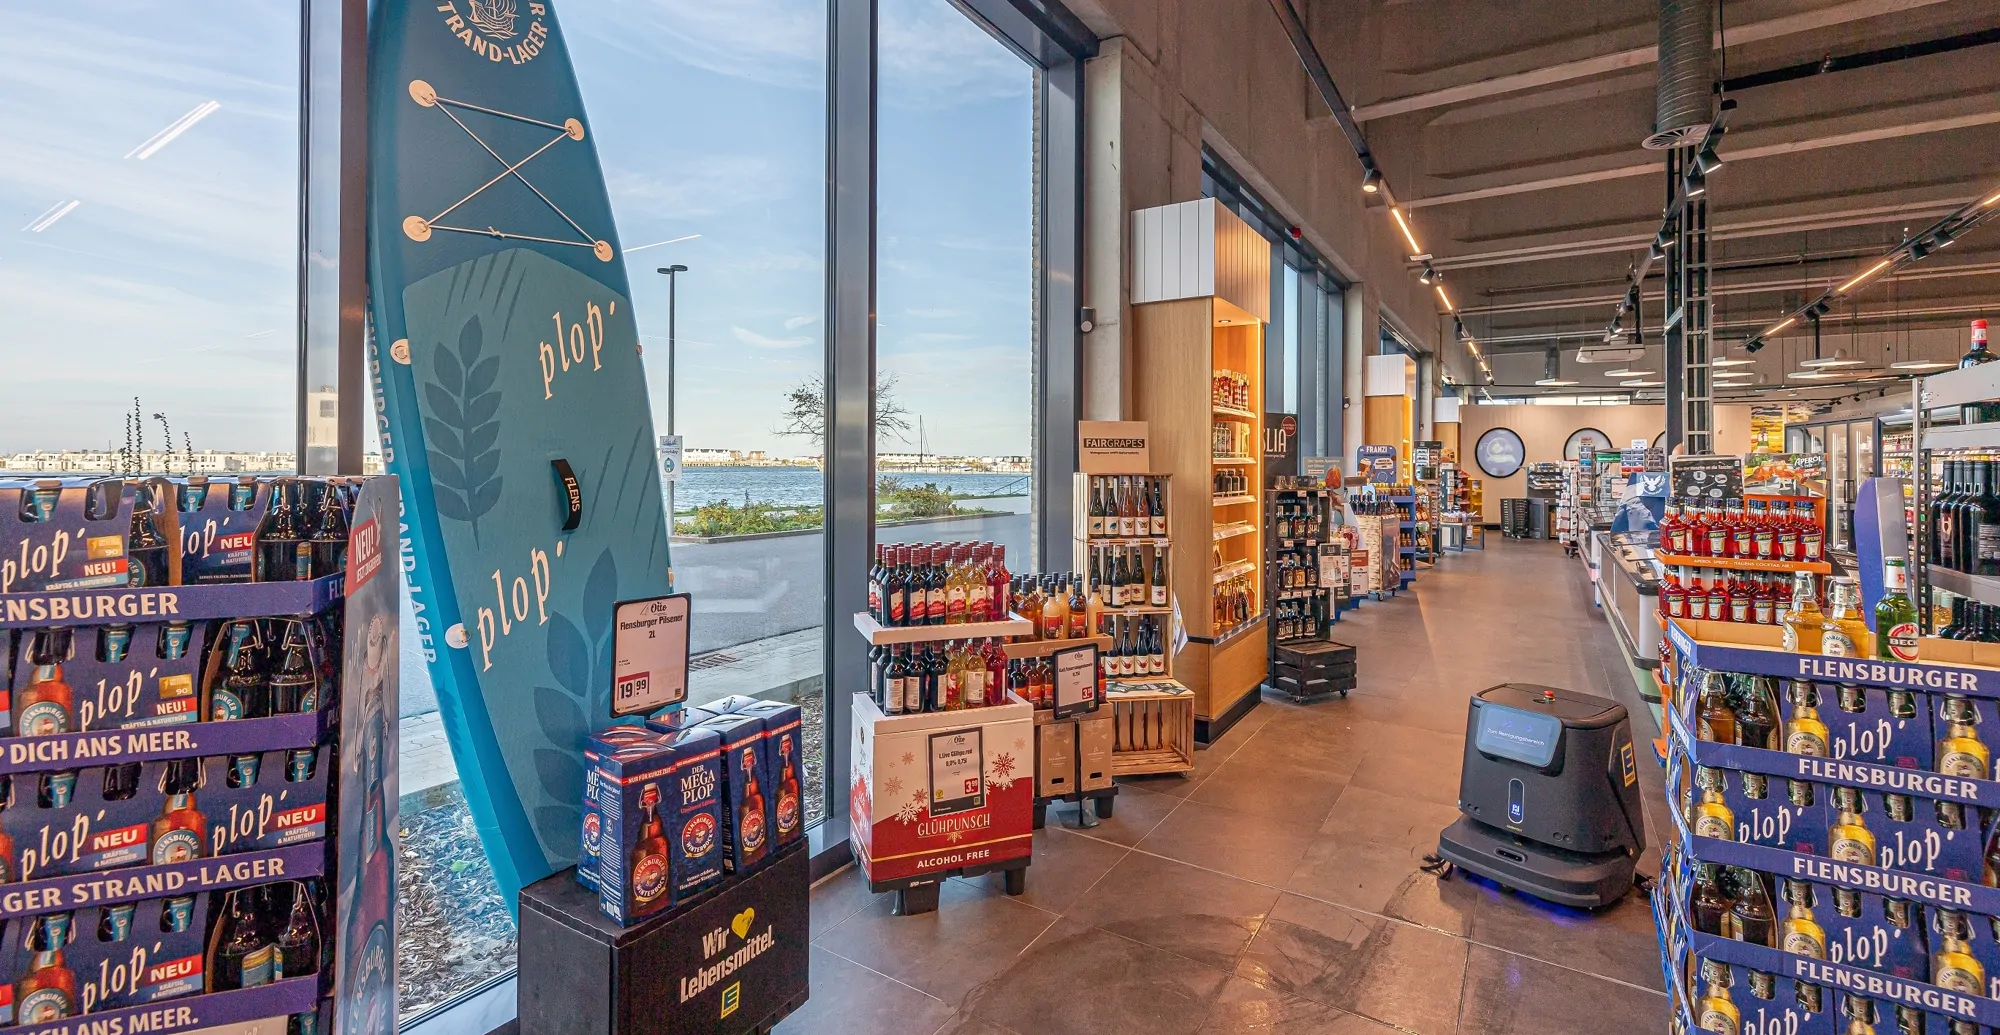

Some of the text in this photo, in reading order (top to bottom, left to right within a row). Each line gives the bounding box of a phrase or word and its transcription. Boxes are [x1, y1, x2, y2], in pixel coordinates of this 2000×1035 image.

[1086, 439, 1144, 448] FAIRGRAPES
[1795, 456, 1822, 466] APEROL
[565, 477, 580, 512] FLENS
[355, 525, 374, 565] NEU!
[84, 562, 117, 577] NEU!
[46, 582, 73, 591] KRÄFTIG
[620, 615, 683, 631] Flensburger Pilsener
[1799, 658, 1978, 692] FLENSBURGER
[156, 700, 187, 715] NEU!
[121, 721, 147, 730] KRÄFTIG
[10, 740, 68, 765] DICH
[74, 735, 122, 759] ANS
[127, 730, 198, 754] MEER.
[628, 776, 639, 784] NUR
[639, 773, 649, 781] FÜR
[649, 769, 663, 779] KURZE
[691, 765, 704, 773] DER
[1799, 758, 1978, 800] FLENSBURGER
[680, 770, 715, 792] MEGA
[683, 784, 714, 805] PLOP
[277, 809, 316, 828] NEU
[686, 816, 714, 838] FLENSBURGER
[917, 812, 991, 837] GLÜHPUNSCH
[94, 829, 138, 850] NEU
[285, 827, 308, 836] KRÄFTIG
[686, 833, 714, 853] WINTERBOCK
[1836, 841, 1869, 859] FLENSBURGER
[635, 857, 666, 880] FLENSBURGER
[917, 849, 990, 869] ALCOHOL FREE
[0, 858, 285, 913] GER STRAND-LAGER
[636, 875, 666, 897] WINTERBOCK
[1793, 857, 1972, 907] FLENSBURGER
[702, 926, 730, 960] Wir
[151, 961, 192, 981] NEU
[680, 924, 775, 1004] Lebensmittel.
[1795, 959, 1977, 1018] FLENSBURGER
[129, 1006, 199, 1034] MEER.
